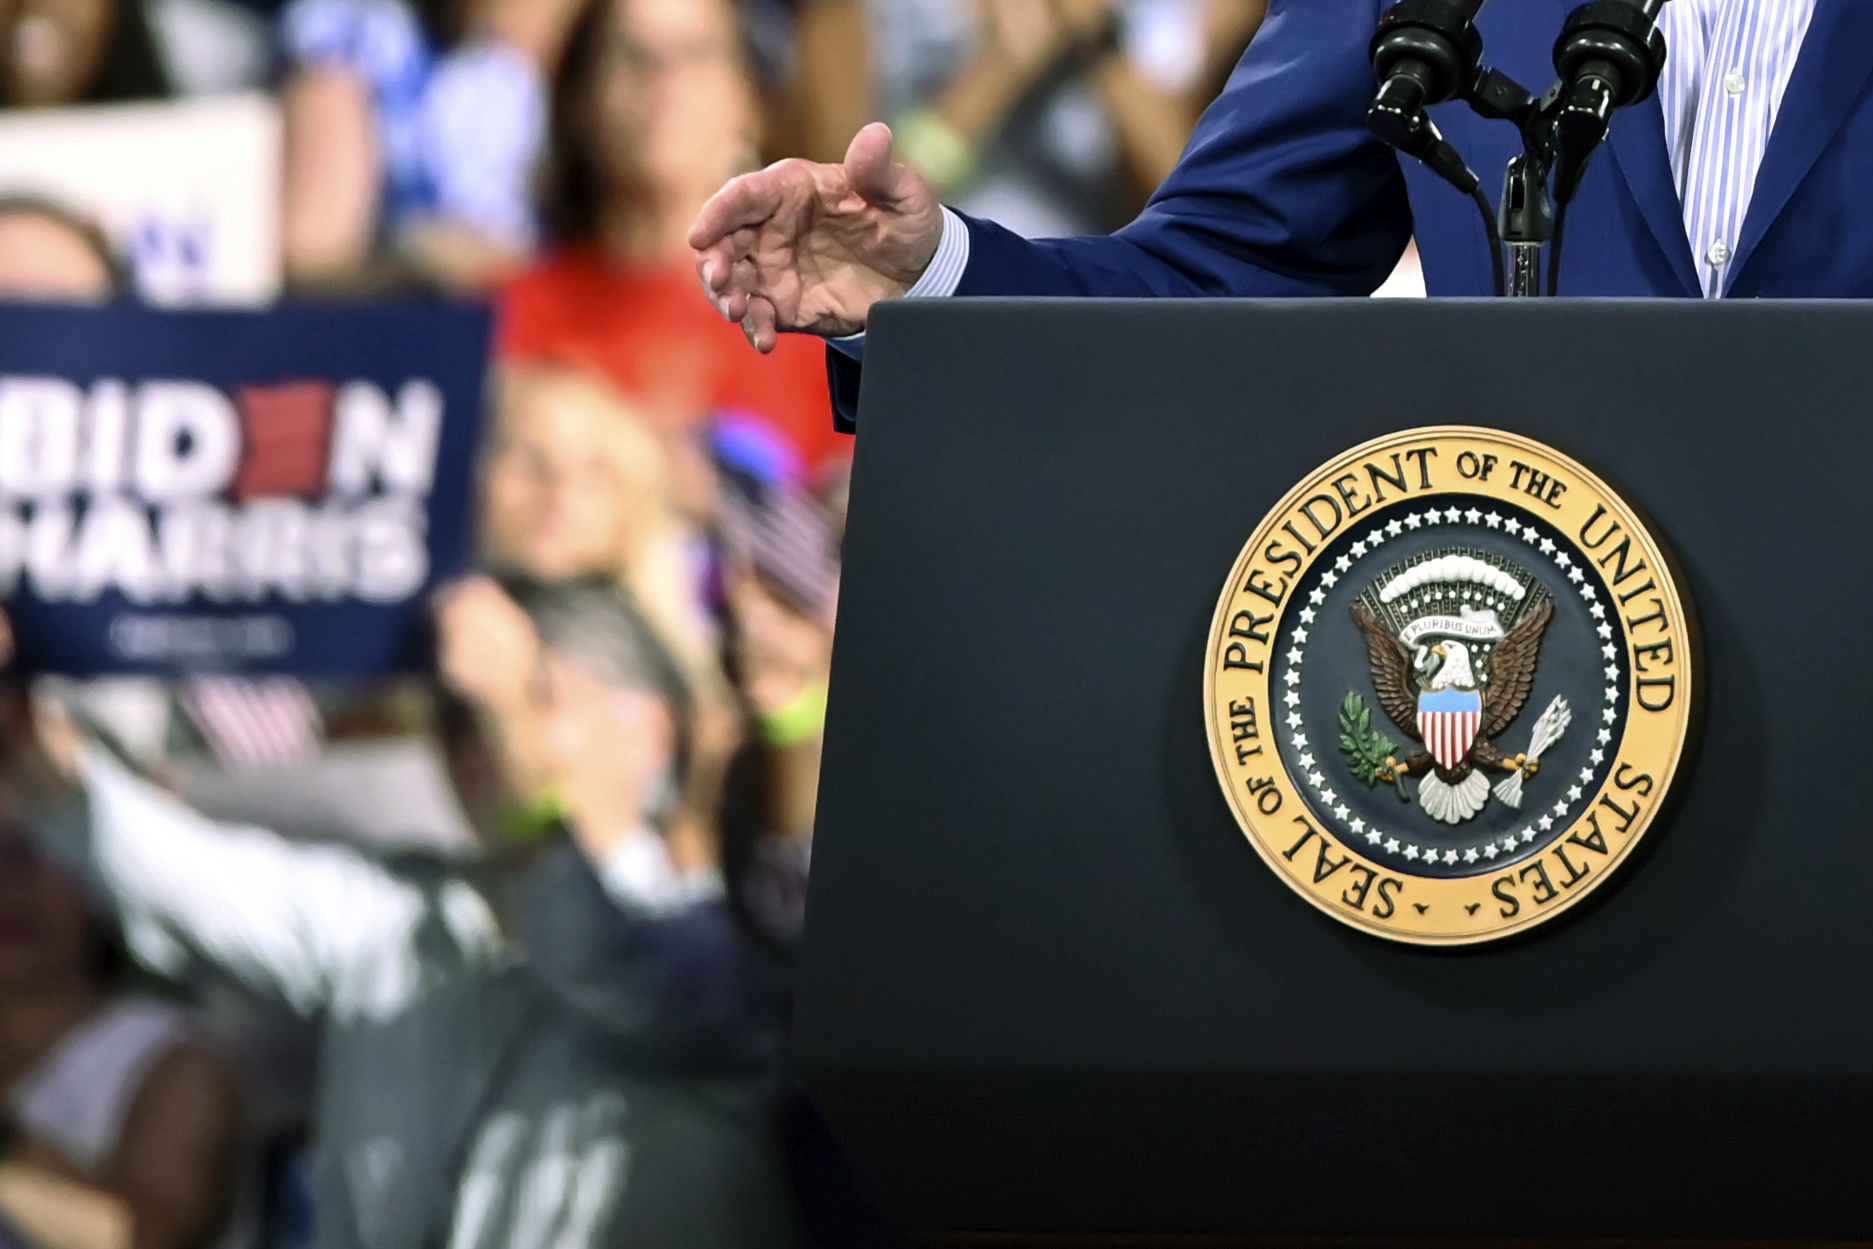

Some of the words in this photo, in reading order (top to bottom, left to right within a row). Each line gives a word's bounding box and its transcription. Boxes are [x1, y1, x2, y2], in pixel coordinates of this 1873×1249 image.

[0, 376, 445, 496] BIDEN
[1456, 450, 1499, 481] OF
[1509, 460, 1568, 510] THE
[1223, 447, 1438, 675] PRESIDENT
[1403, 630, 1412, 642] E
[1412, 618, 1464, 634] PLURIBUS
[1465, 624, 1496, 636] UNUM
[1578, 503, 1675, 713] UNITED
[1229, 696, 1265, 767] THE
[1248, 776, 1284, 817] OF
[1491, 760, 1654, 919] STATES
[1283, 814, 1404, 920] SEAL
